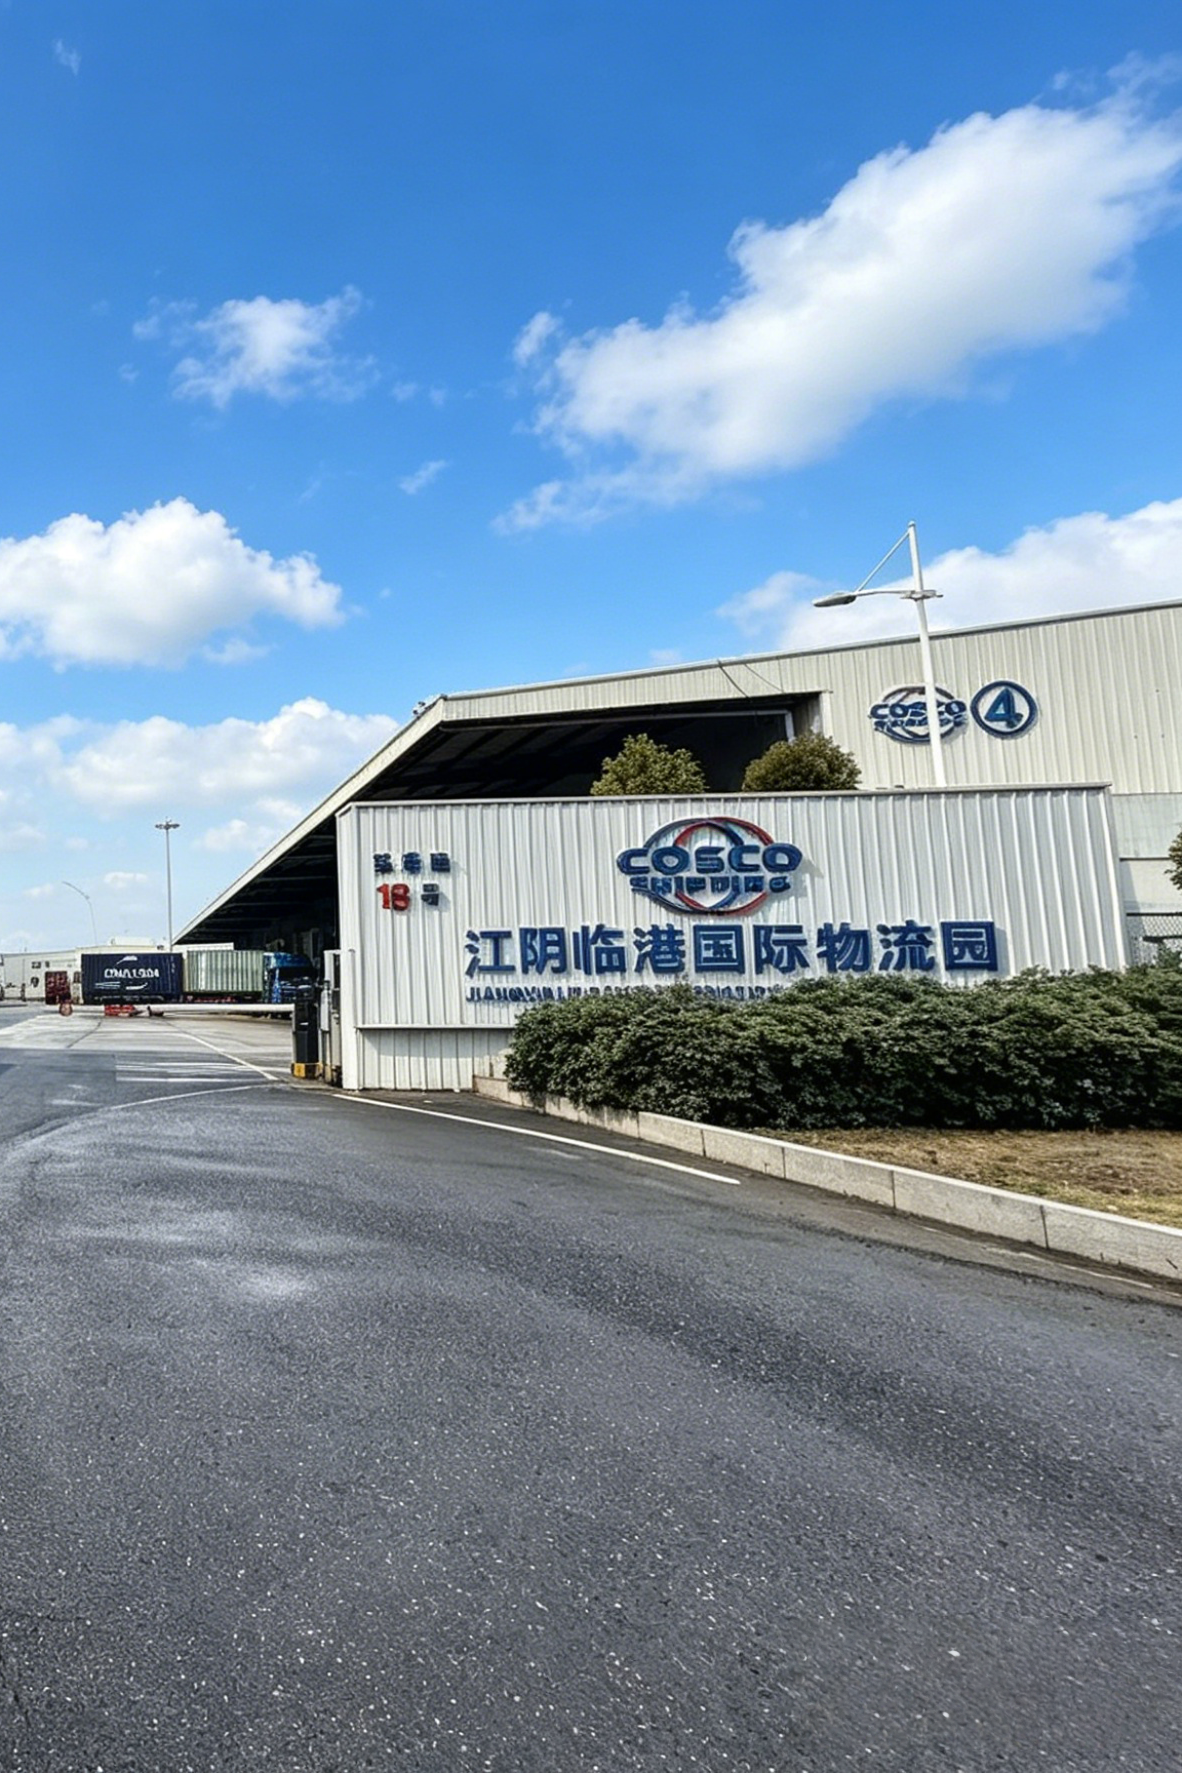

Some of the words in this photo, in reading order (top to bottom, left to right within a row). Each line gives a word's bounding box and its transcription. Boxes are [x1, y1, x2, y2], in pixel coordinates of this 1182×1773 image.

[984, 687, 1023, 729] 4
[616, 843, 803, 875] COSCO
[465, 920, 998, 978] 江阴临港国际物流园
